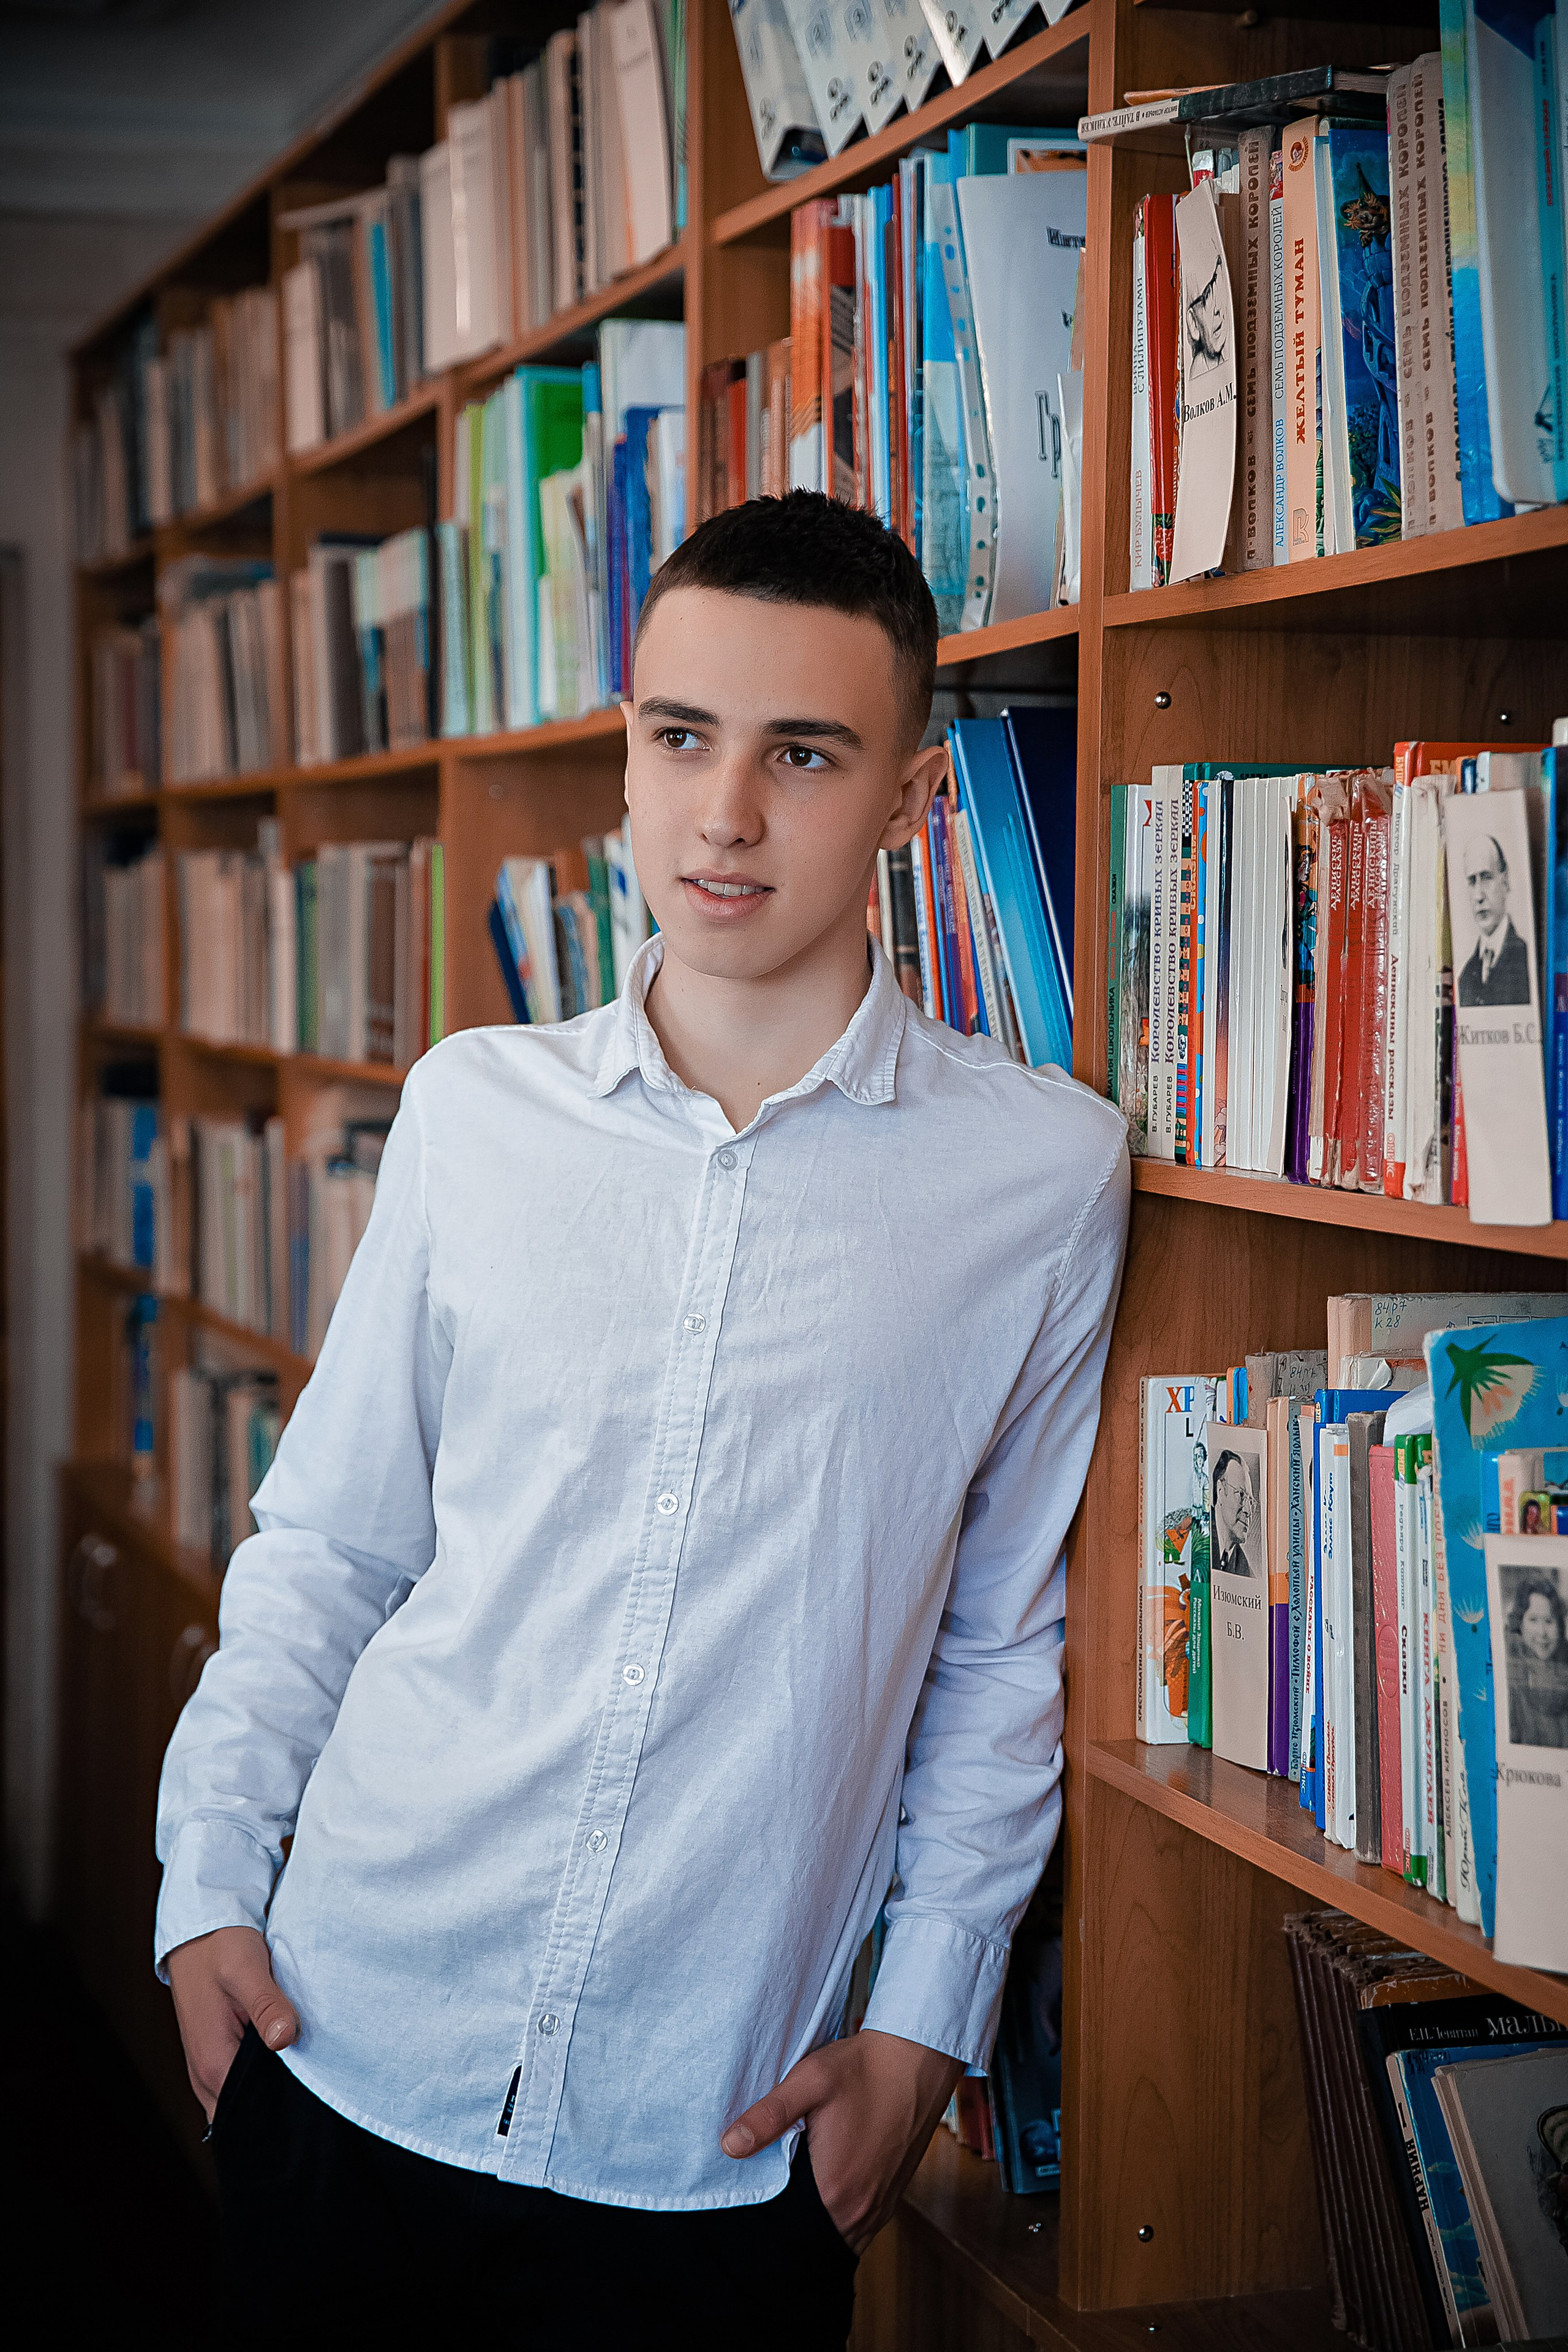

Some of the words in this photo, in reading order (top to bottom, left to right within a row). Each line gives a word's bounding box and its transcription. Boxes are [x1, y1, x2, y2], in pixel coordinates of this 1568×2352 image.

[1396, 83, 1409, 178] КОРОЛЕЙ
[1413, 74, 1426, 168] КОРОЛЕЙ
[1245, 141, 1259, 229] КОРОЛЕЙ
[1272, 205, 1283, 271] КОРОЛЕЙ
[1398, 185, 1411, 317] ПОДЗЕМНЫХ
[1417, 175, 1429, 309] ПОДЗЕМНЫХ
[1245, 236, 1257, 359] ПОДЗЕМНЫХ
[1294, 237, 1305, 325] ТУМАН
[1274, 272, 1284, 360] ПОДЗЕМНЫХ
[1421, 317, 1431, 371] СЕМЬ
[1275, 363, 1284, 399] СЕМЬ
[1403, 325, 1412, 379] СЕМЬ
[1138, 383, 1144, 393] С
[1184, 400, 1215, 423] Волков
[1216, 382, 1237, 408] А.М.
[1246, 369, 1256, 417] СЕМЬ
[1292, 331, 1306, 445] ЖЕЛТЫЙ
[1275, 475, 1286, 547] АЛЕКСАНДР
[1155, 799, 1163, 864] ЗЕРКАЛ
[1170, 799, 1179, 864] ЗЕРКАЛ
[1350, 822, 1359, 910] ДЕНИСКИНЫ
[1367, 820, 1377, 909] ДЕНИСКИНЫ
[1374, 830, 1384, 900] РАССКАЗЫ
[1169, 869, 1178, 937] КРИВЫХ
[1392, 862, 1400, 936] Драгунский
[1151, 943, 1162, 1064] КОРОЛЕВСТВО
[1165, 943, 1176, 1065] КОРОЛЕВСТВО
[1390, 954, 1400, 1044] Денискины
[1385, 1314, 1401, 1329] 28
[1291, 1518, 1303, 1558] улицы
[1436, 1551, 1444, 1581] БЕЗ
[1212, 1584, 1262, 1610] Изюмский
[1227, 1621, 1245, 1641] Б.В.
[1438, 1591, 1447, 1624] ДНЯ
[1438, 1633, 1446, 1654] НИ
[1291, 1743, 1300, 1770] Борис
[1425, 1697, 1434, 1825] ДЖУНГЛЕЙ
[1443, 1778, 1452, 1838] АЛЕКСЕЙ
[1404, 2137, 1430, 2212] НАРНИЯ
